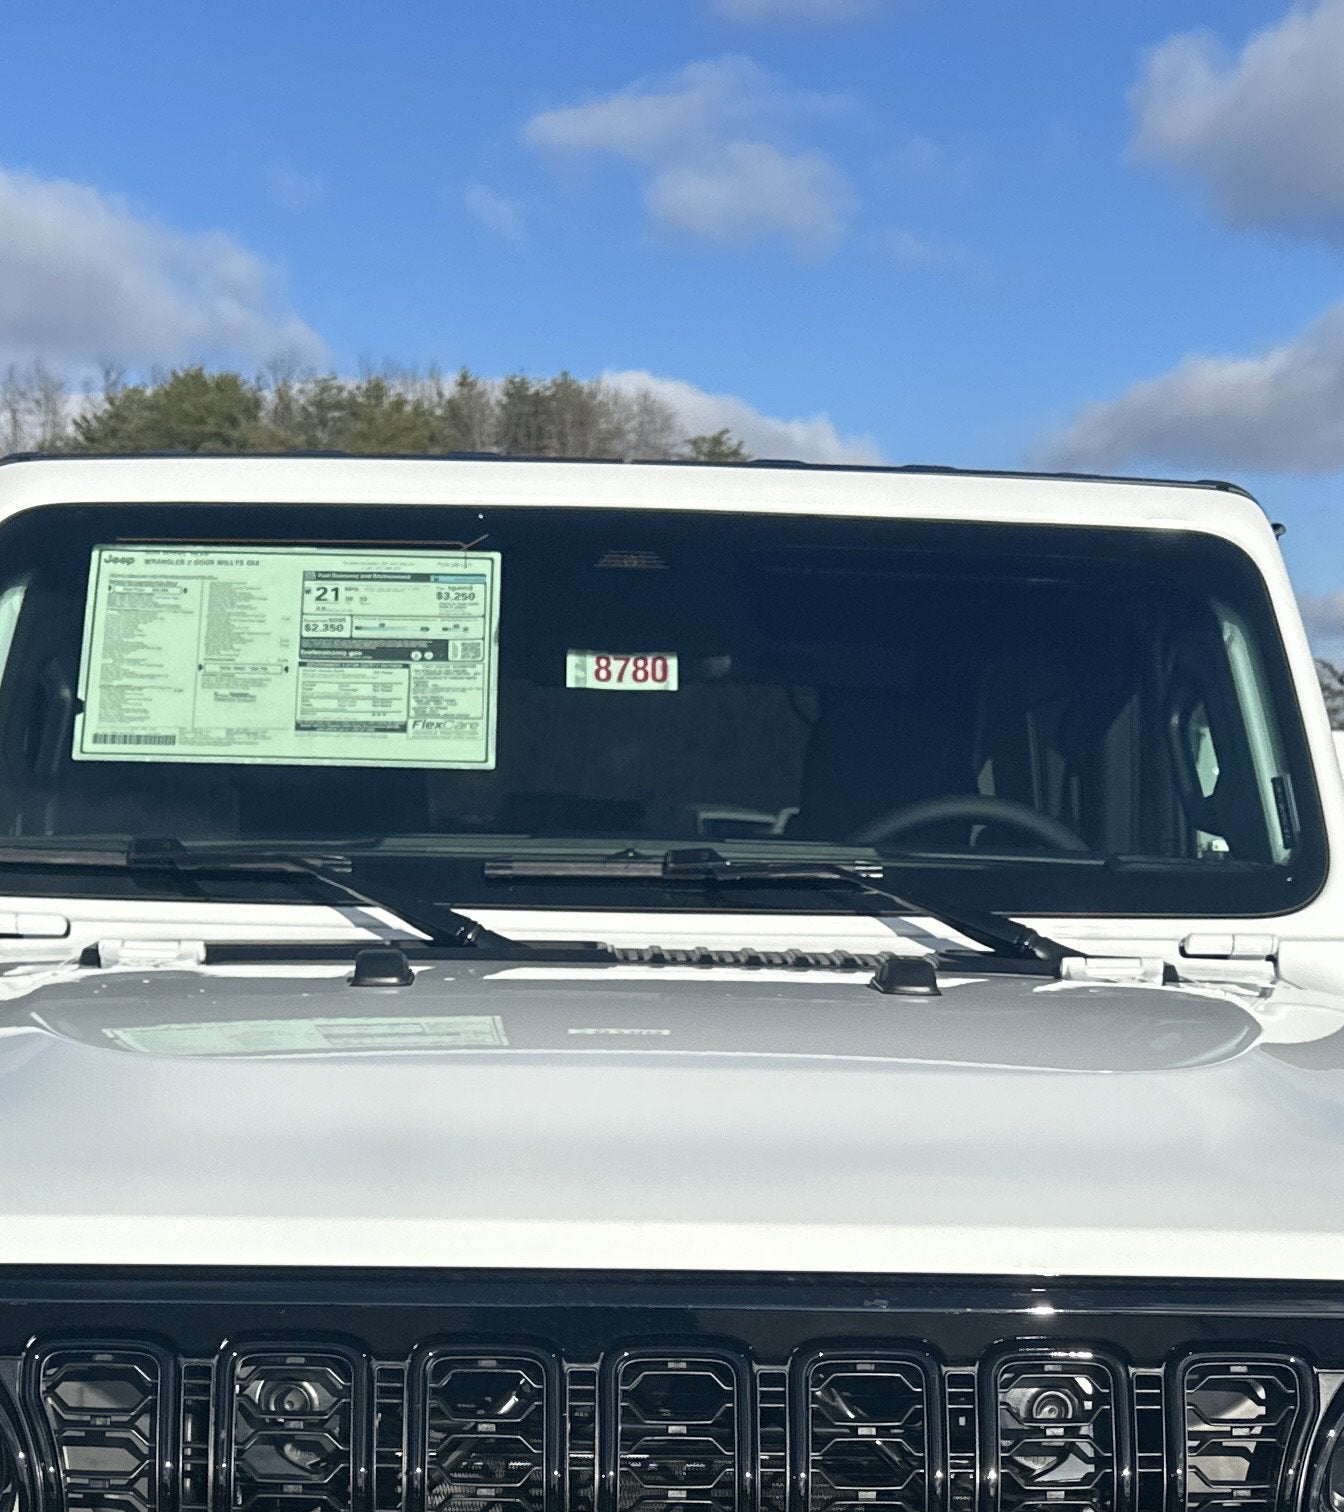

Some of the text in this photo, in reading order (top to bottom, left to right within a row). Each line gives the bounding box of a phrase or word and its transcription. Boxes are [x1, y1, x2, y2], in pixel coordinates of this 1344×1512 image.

[103, 554, 135, 566] Jeep
[315, 586, 339, 602] 21
[594, 655, 668, 683] 8780
